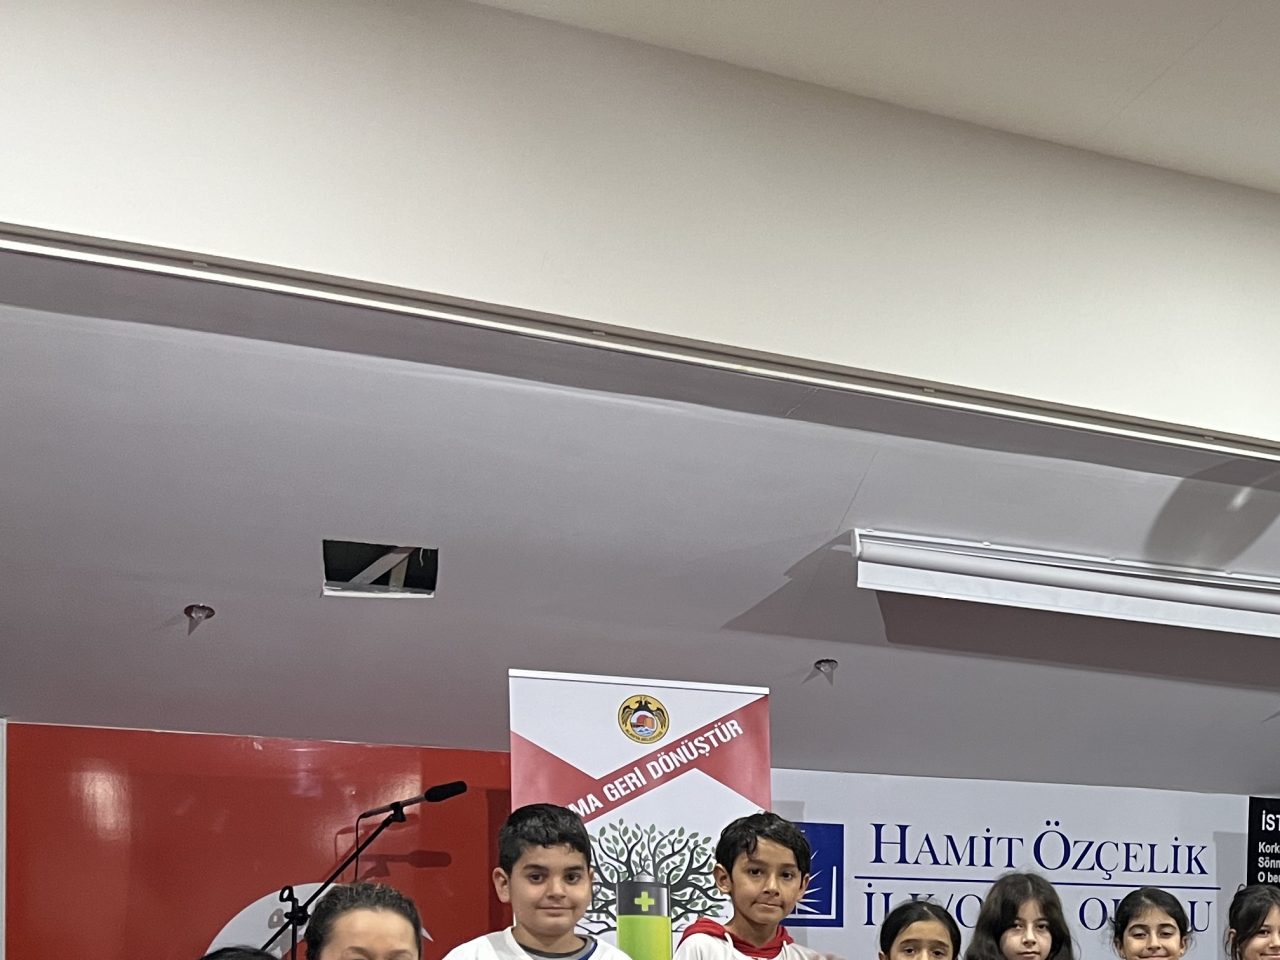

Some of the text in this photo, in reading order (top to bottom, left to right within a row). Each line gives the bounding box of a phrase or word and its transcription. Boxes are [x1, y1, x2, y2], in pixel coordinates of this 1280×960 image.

[602, 766, 647, 802] GERİ
[646, 719, 743, 780] DÖNÜŞTÜR
[869, 820, 1209, 881] HAMİT ÖZÇELİK
[1257, 871, 1266, 883] O
